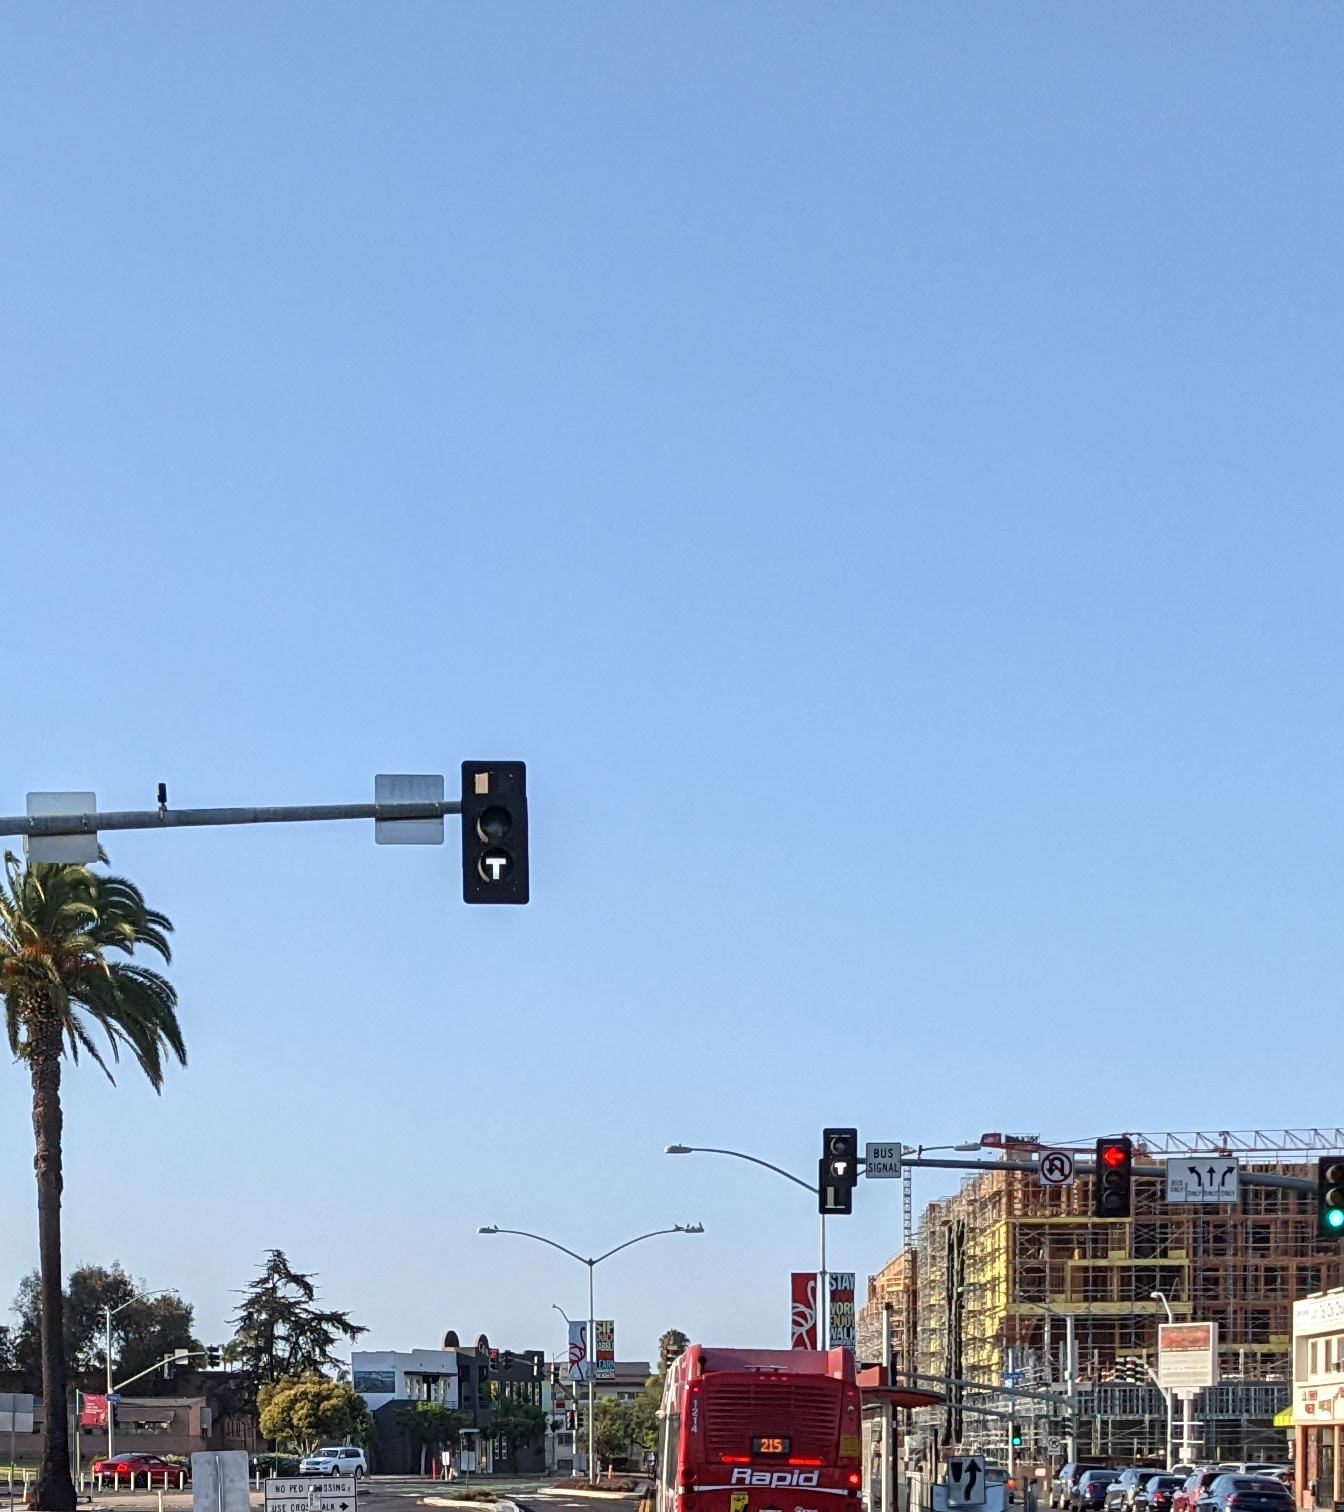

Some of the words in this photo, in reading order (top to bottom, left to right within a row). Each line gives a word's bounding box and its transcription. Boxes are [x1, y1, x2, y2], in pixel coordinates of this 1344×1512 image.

[873, 1148, 894, 1159] BUS
[867, 1162, 900, 1174] SIGNAL
[829, 1274, 855, 1291] STAY
[596, 1321, 614, 1334] SIP
[760, 1438, 783, 1453] 215
[731, 1468, 819, 1488] Rapid
[275, 1484, 286, 1494] NO
[289, 1484, 304, 1493] PED
[308, 1483, 346, 1493] SSING
[272, 1503, 286, 1512] USE
[290, 1503, 336, 1512] CROALK
